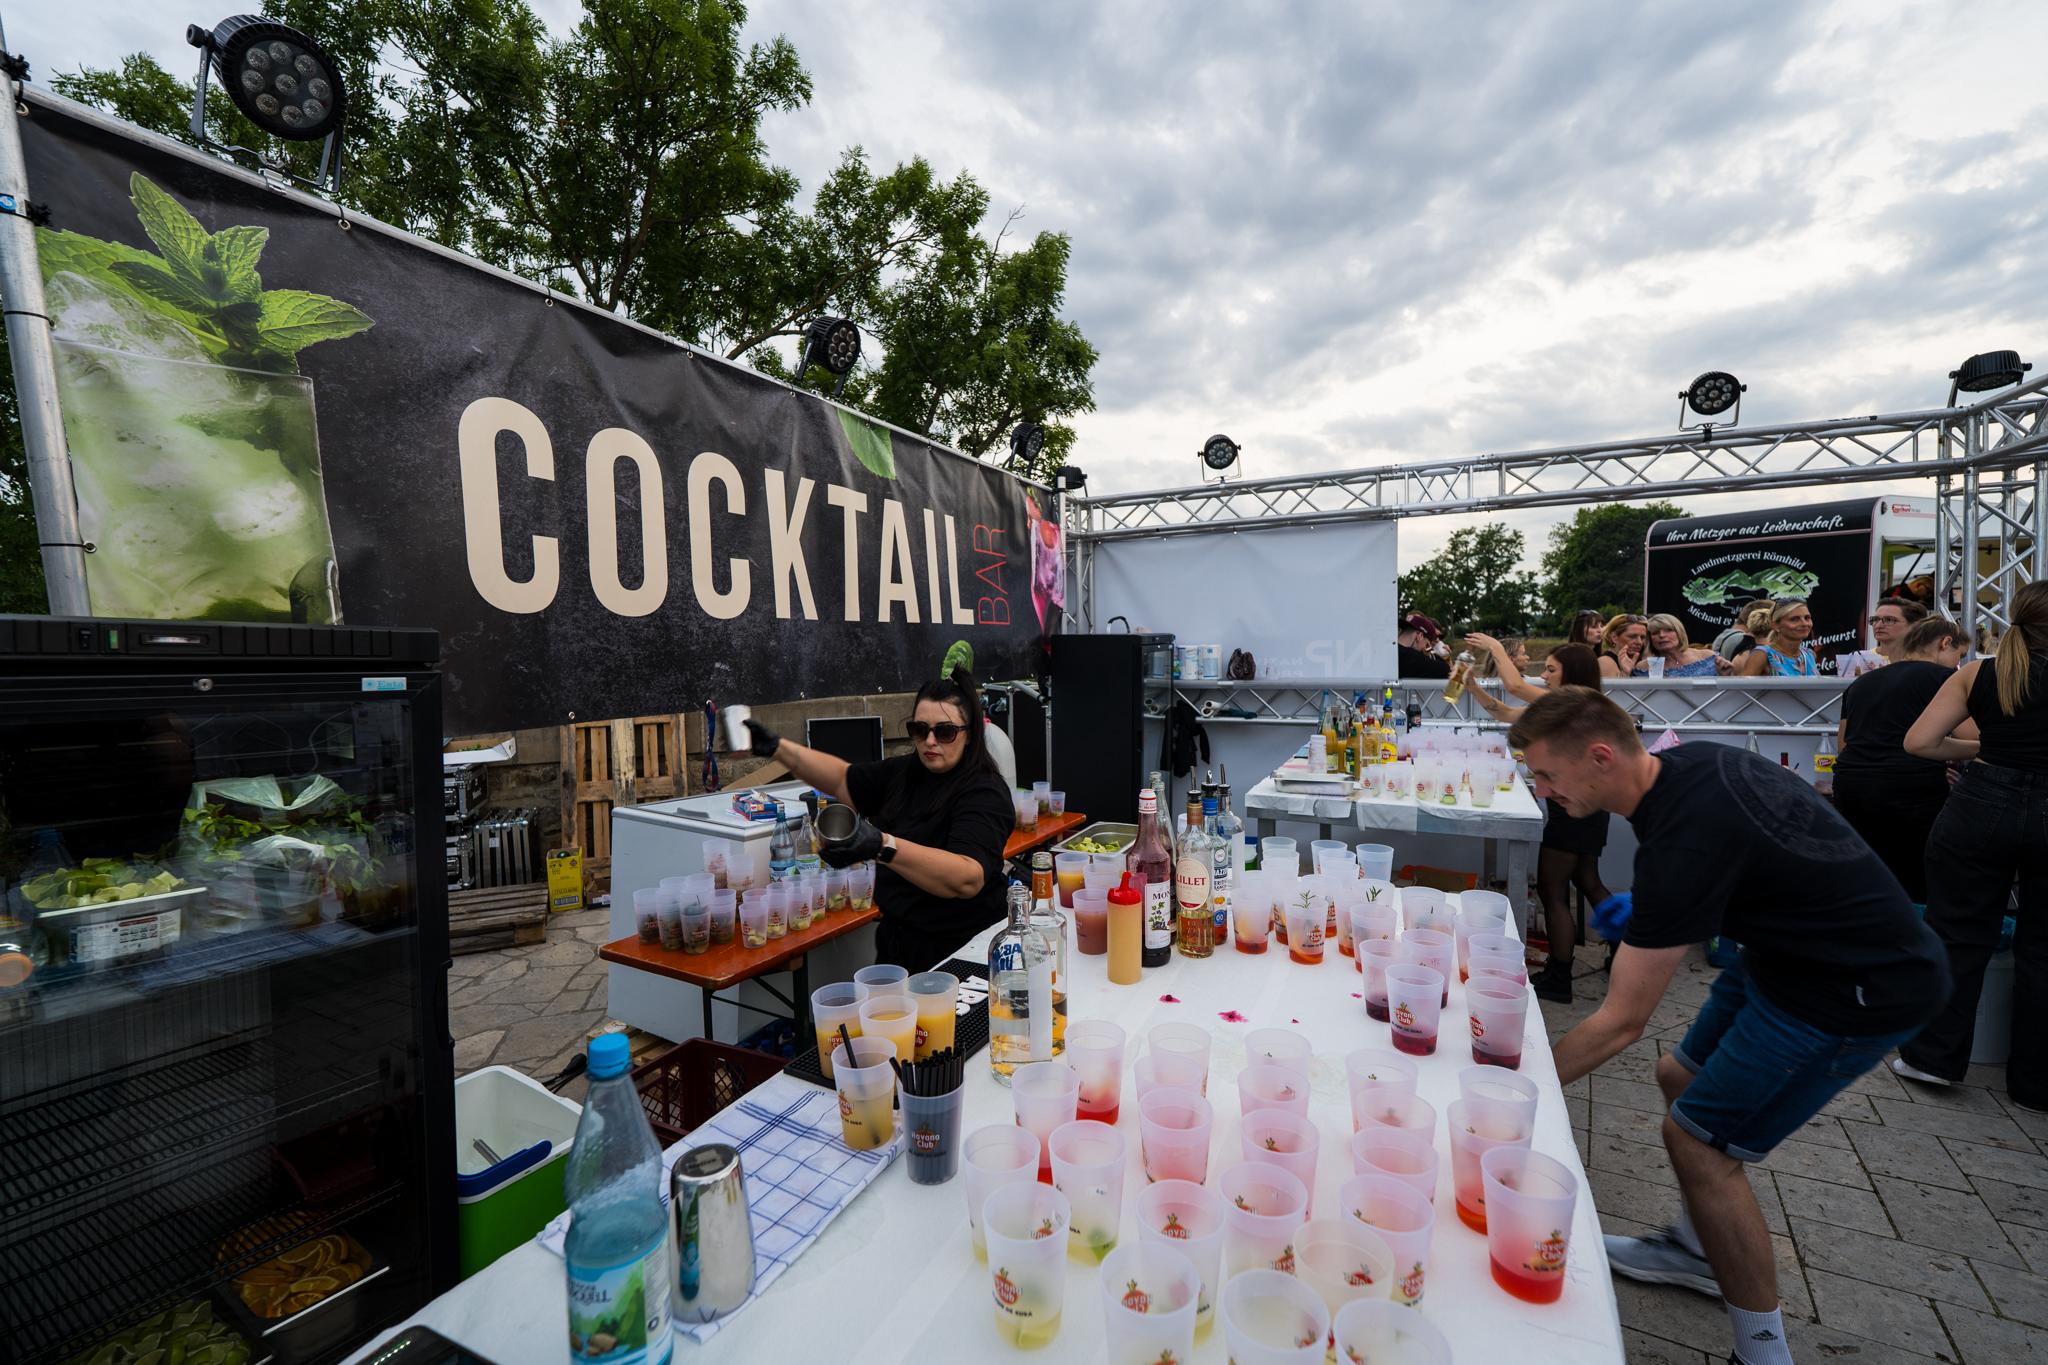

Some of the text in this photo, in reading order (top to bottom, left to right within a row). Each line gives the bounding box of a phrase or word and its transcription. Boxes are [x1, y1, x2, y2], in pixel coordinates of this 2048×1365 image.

[458, 396, 974, 626] COCKTAIL
[1666, 515, 1844, 542] Ihre Metzger aus Leidenschaft.
[974, 524, 1010, 625] BAR
[1691, 551, 1807, 576] Landmetzgerei Römhild
[1687, 604, 1722, 625] Michael
[1723, 618, 1732, 626] &
